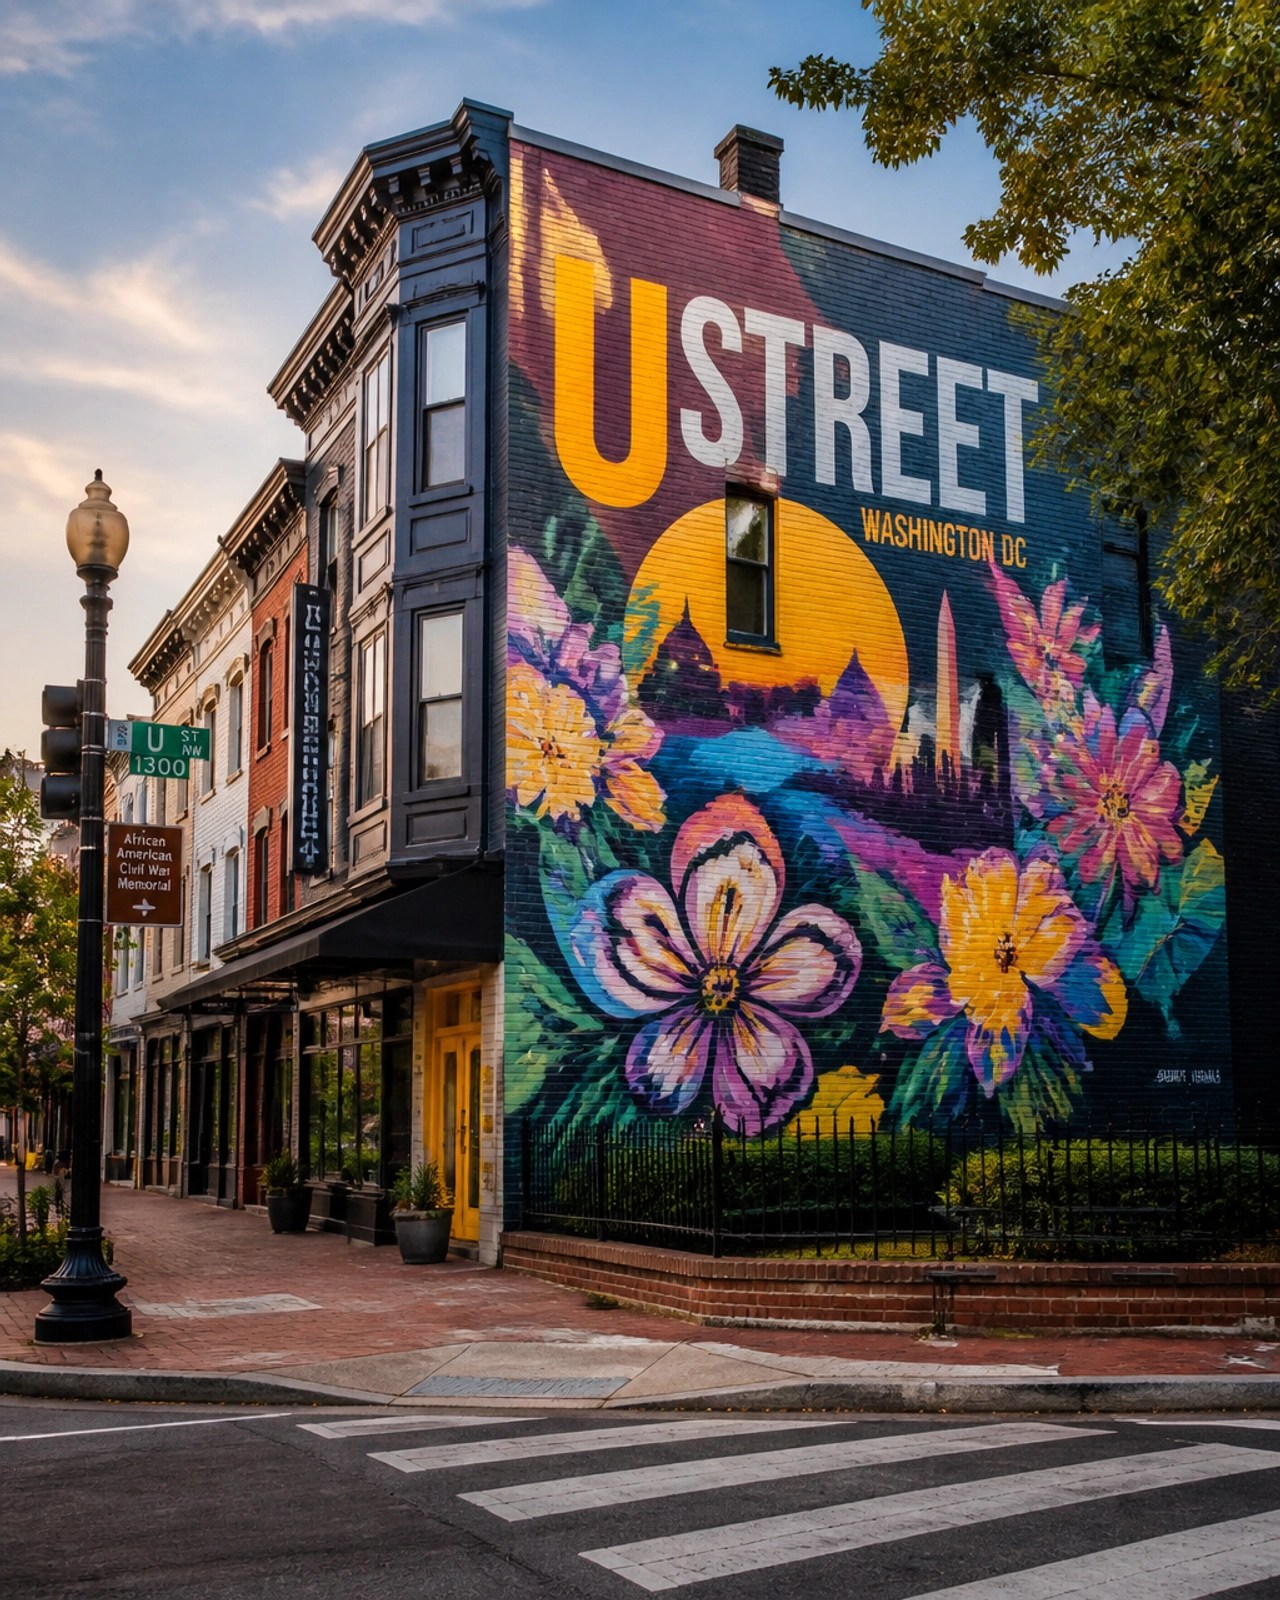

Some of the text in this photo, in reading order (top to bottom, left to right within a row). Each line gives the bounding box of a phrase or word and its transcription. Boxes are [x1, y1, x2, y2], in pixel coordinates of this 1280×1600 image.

[554, 254, 1039, 524] U STREET
[859, 506, 1027, 568] WASHINGTON DC
[147, 726, 164, 752] U
[180, 729, 200, 742] ST
[181, 745, 203, 757] NW
[134, 755, 186, 776] 1300
[116, 847, 173, 862] American
